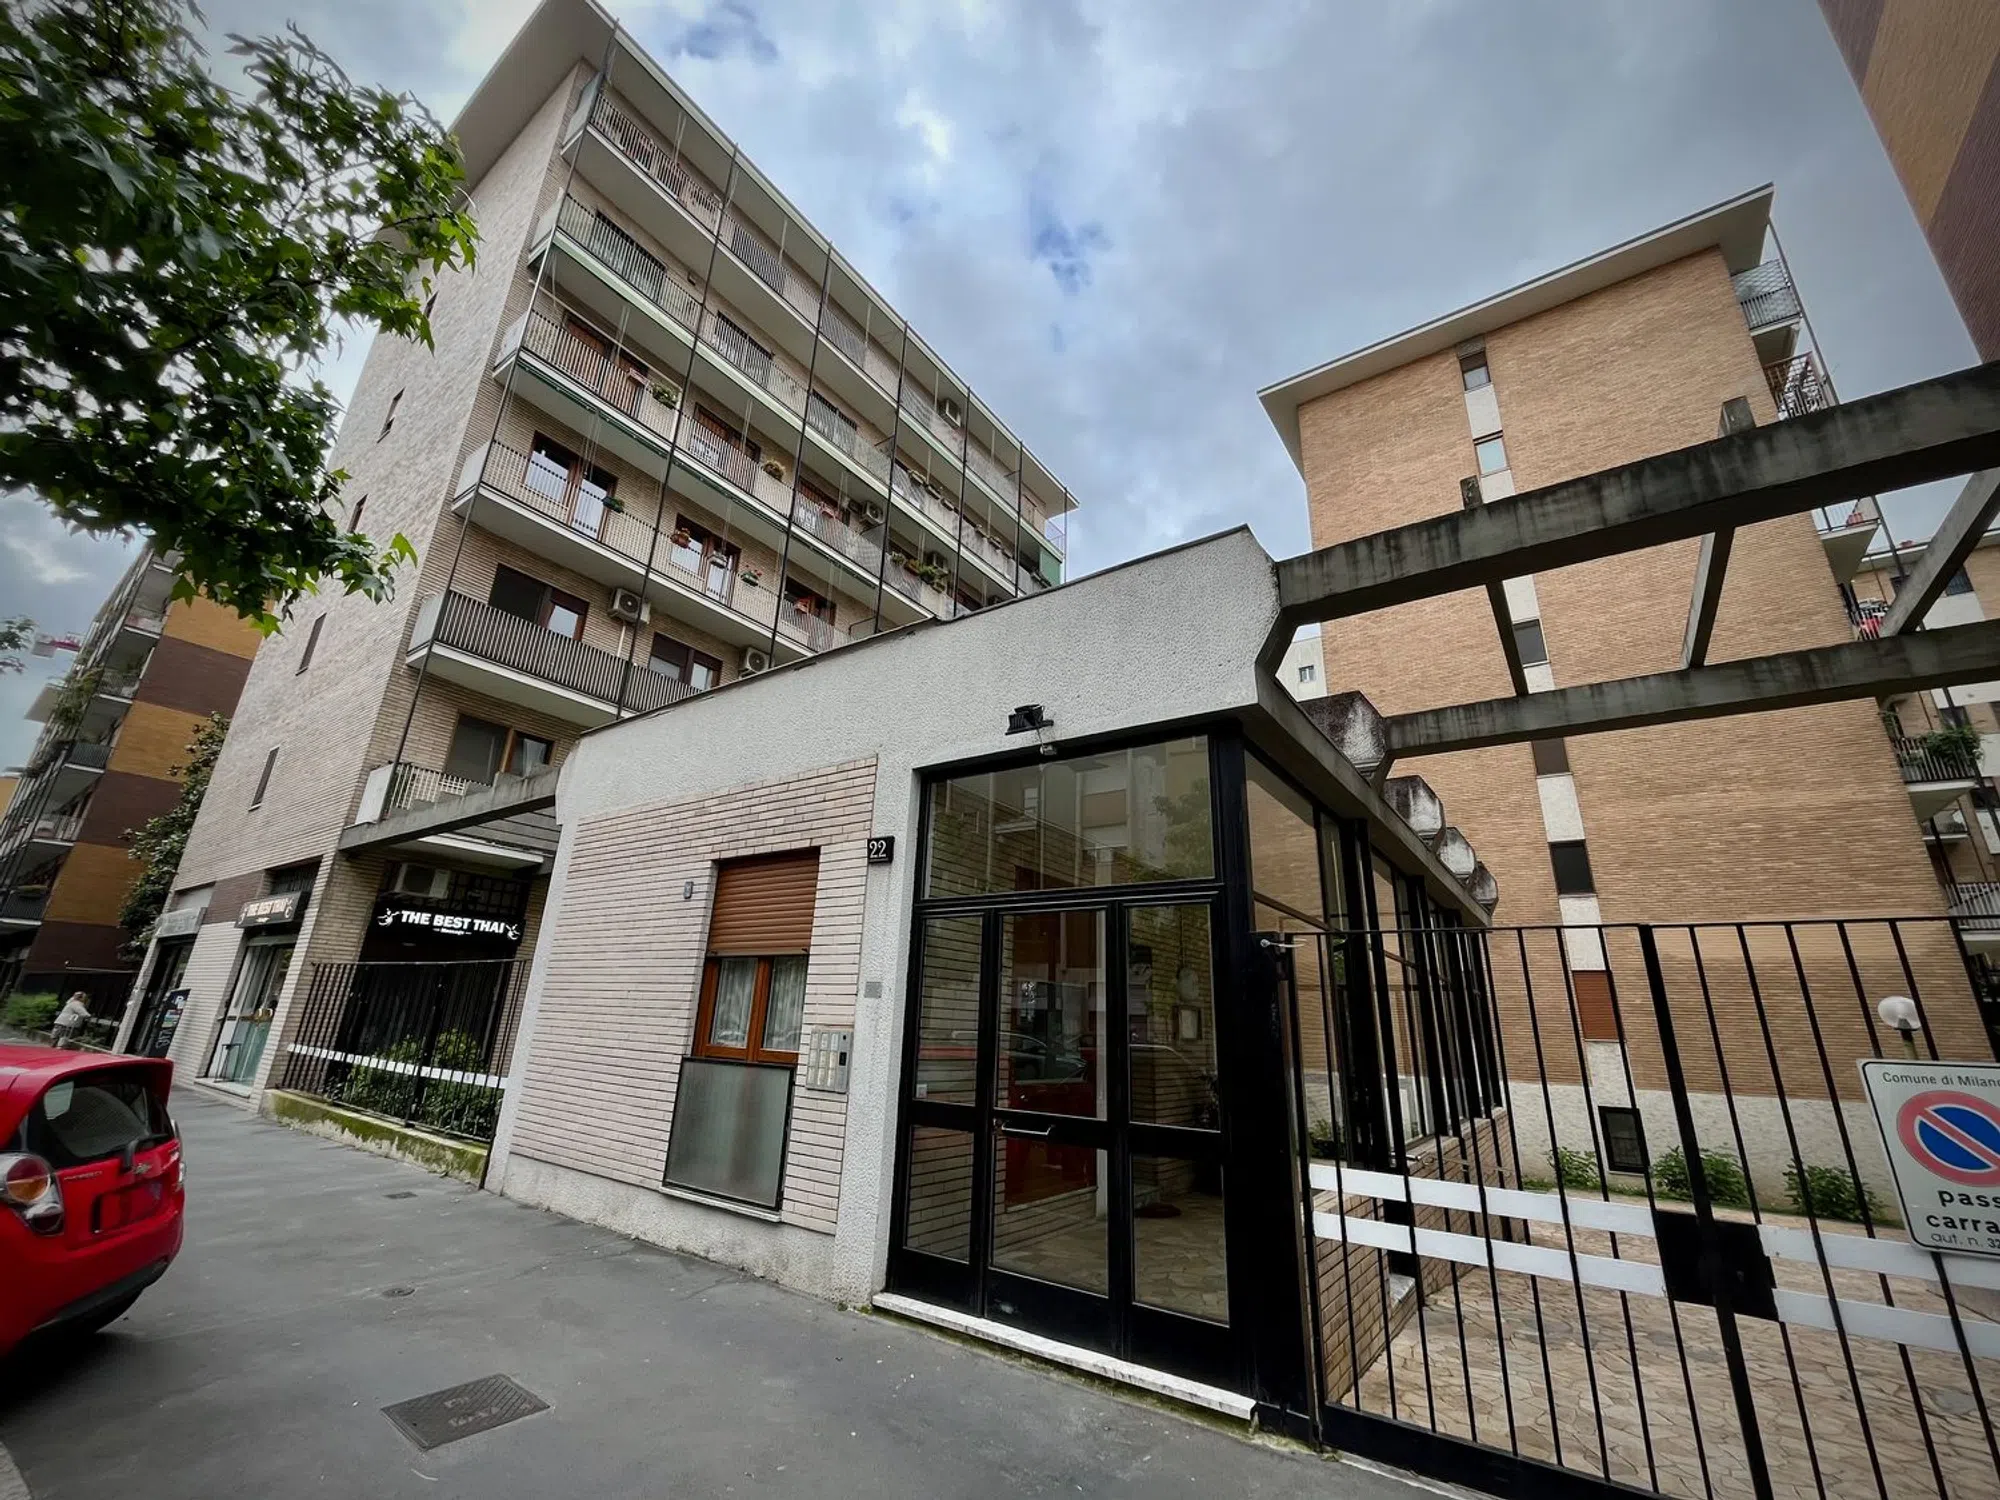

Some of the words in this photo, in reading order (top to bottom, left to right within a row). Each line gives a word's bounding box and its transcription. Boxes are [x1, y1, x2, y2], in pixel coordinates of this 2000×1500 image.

[870, 840, 887, 858] 22
[401, 910, 431, 926] THE
[433, 914, 472, 930] BEST
[473, 919, 505, 934] THAI
[1882, 1072, 1937, 1085] Comune
[1941, 1075, 1954, 1086] di
